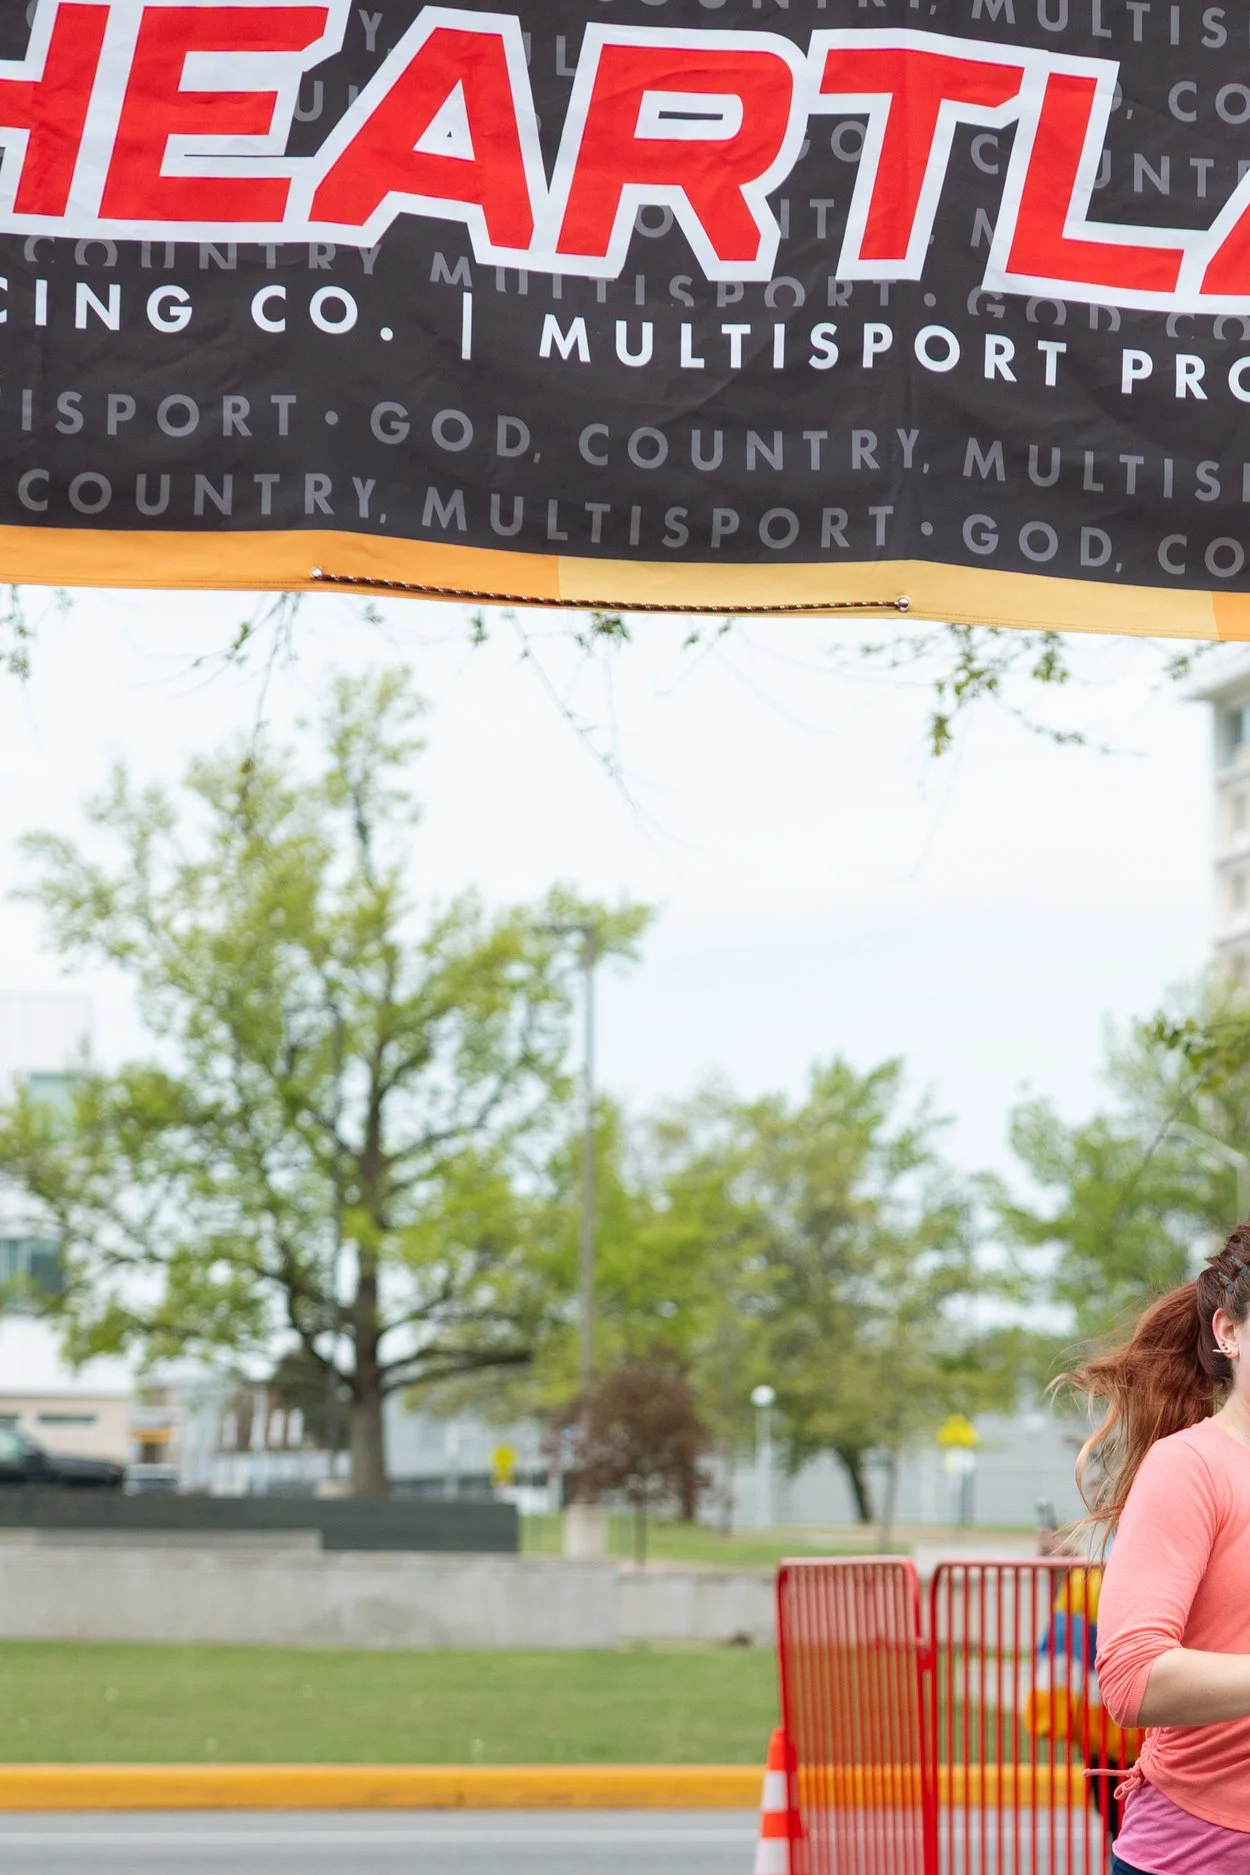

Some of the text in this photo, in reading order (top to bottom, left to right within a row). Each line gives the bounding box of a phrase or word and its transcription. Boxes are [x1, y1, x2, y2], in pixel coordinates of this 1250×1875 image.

[0, 276, 193, 334] ING
[250, 284, 394, 343] CO.
[538, 313, 1067, 387] MULTISPORT
[20, 389, 297, 438] ISPORT
[371, 402, 541, 464] GOD,
[579, 424, 930, 474] COUNTRY,
[18, 469, 387, 525] COUNTRY,
[422, 487, 895, 550] MULTISPORT
[962, 514, 1123, 574] GOD,
